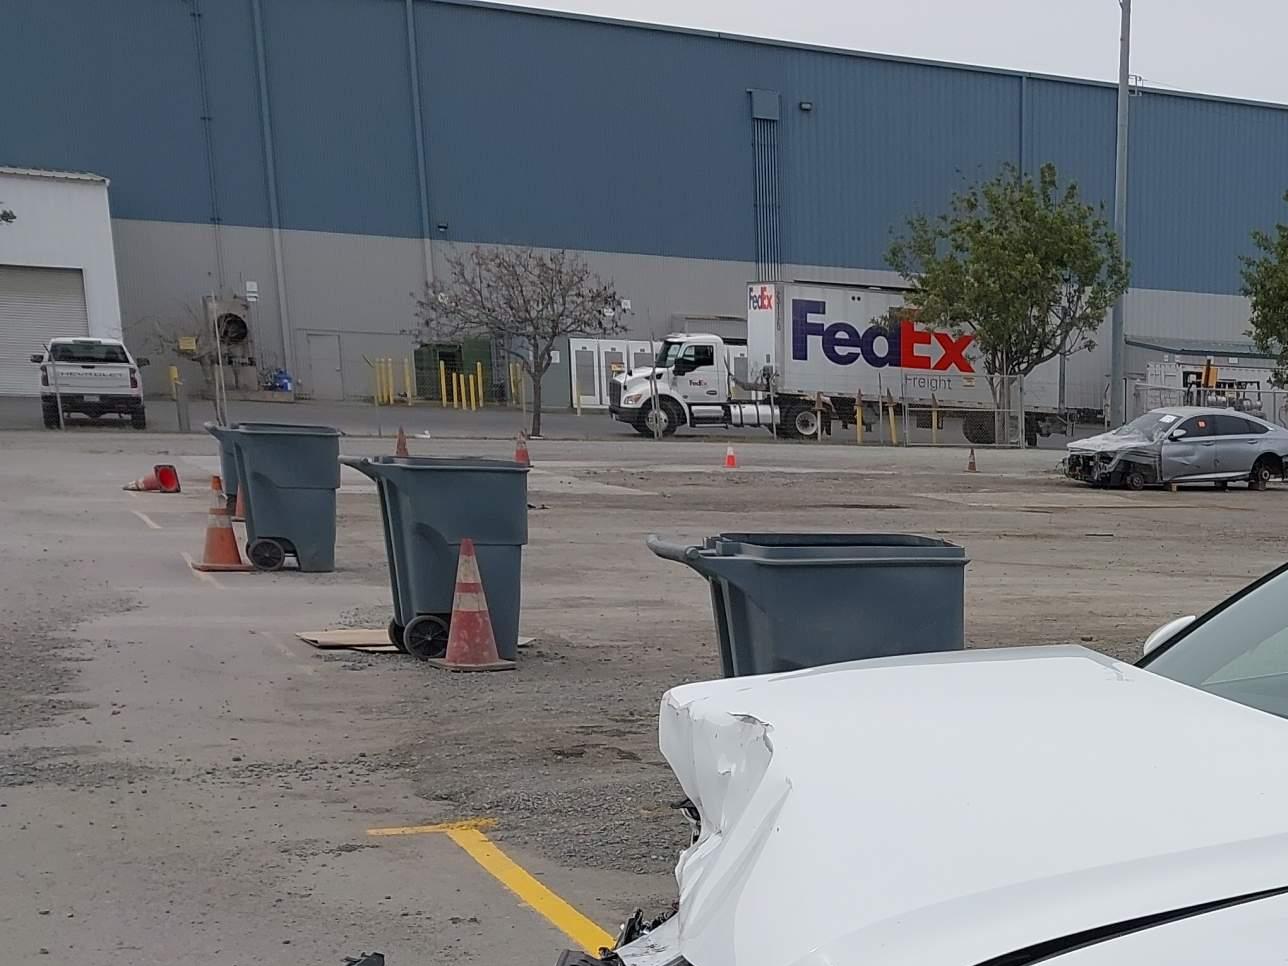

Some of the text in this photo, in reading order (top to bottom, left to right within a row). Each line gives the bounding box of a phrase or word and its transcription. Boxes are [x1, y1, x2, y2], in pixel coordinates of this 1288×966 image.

[749, 286, 772, 310] FedEx
[792, 299, 976, 373] FedEx
[905, 374, 952, 391] Freight
